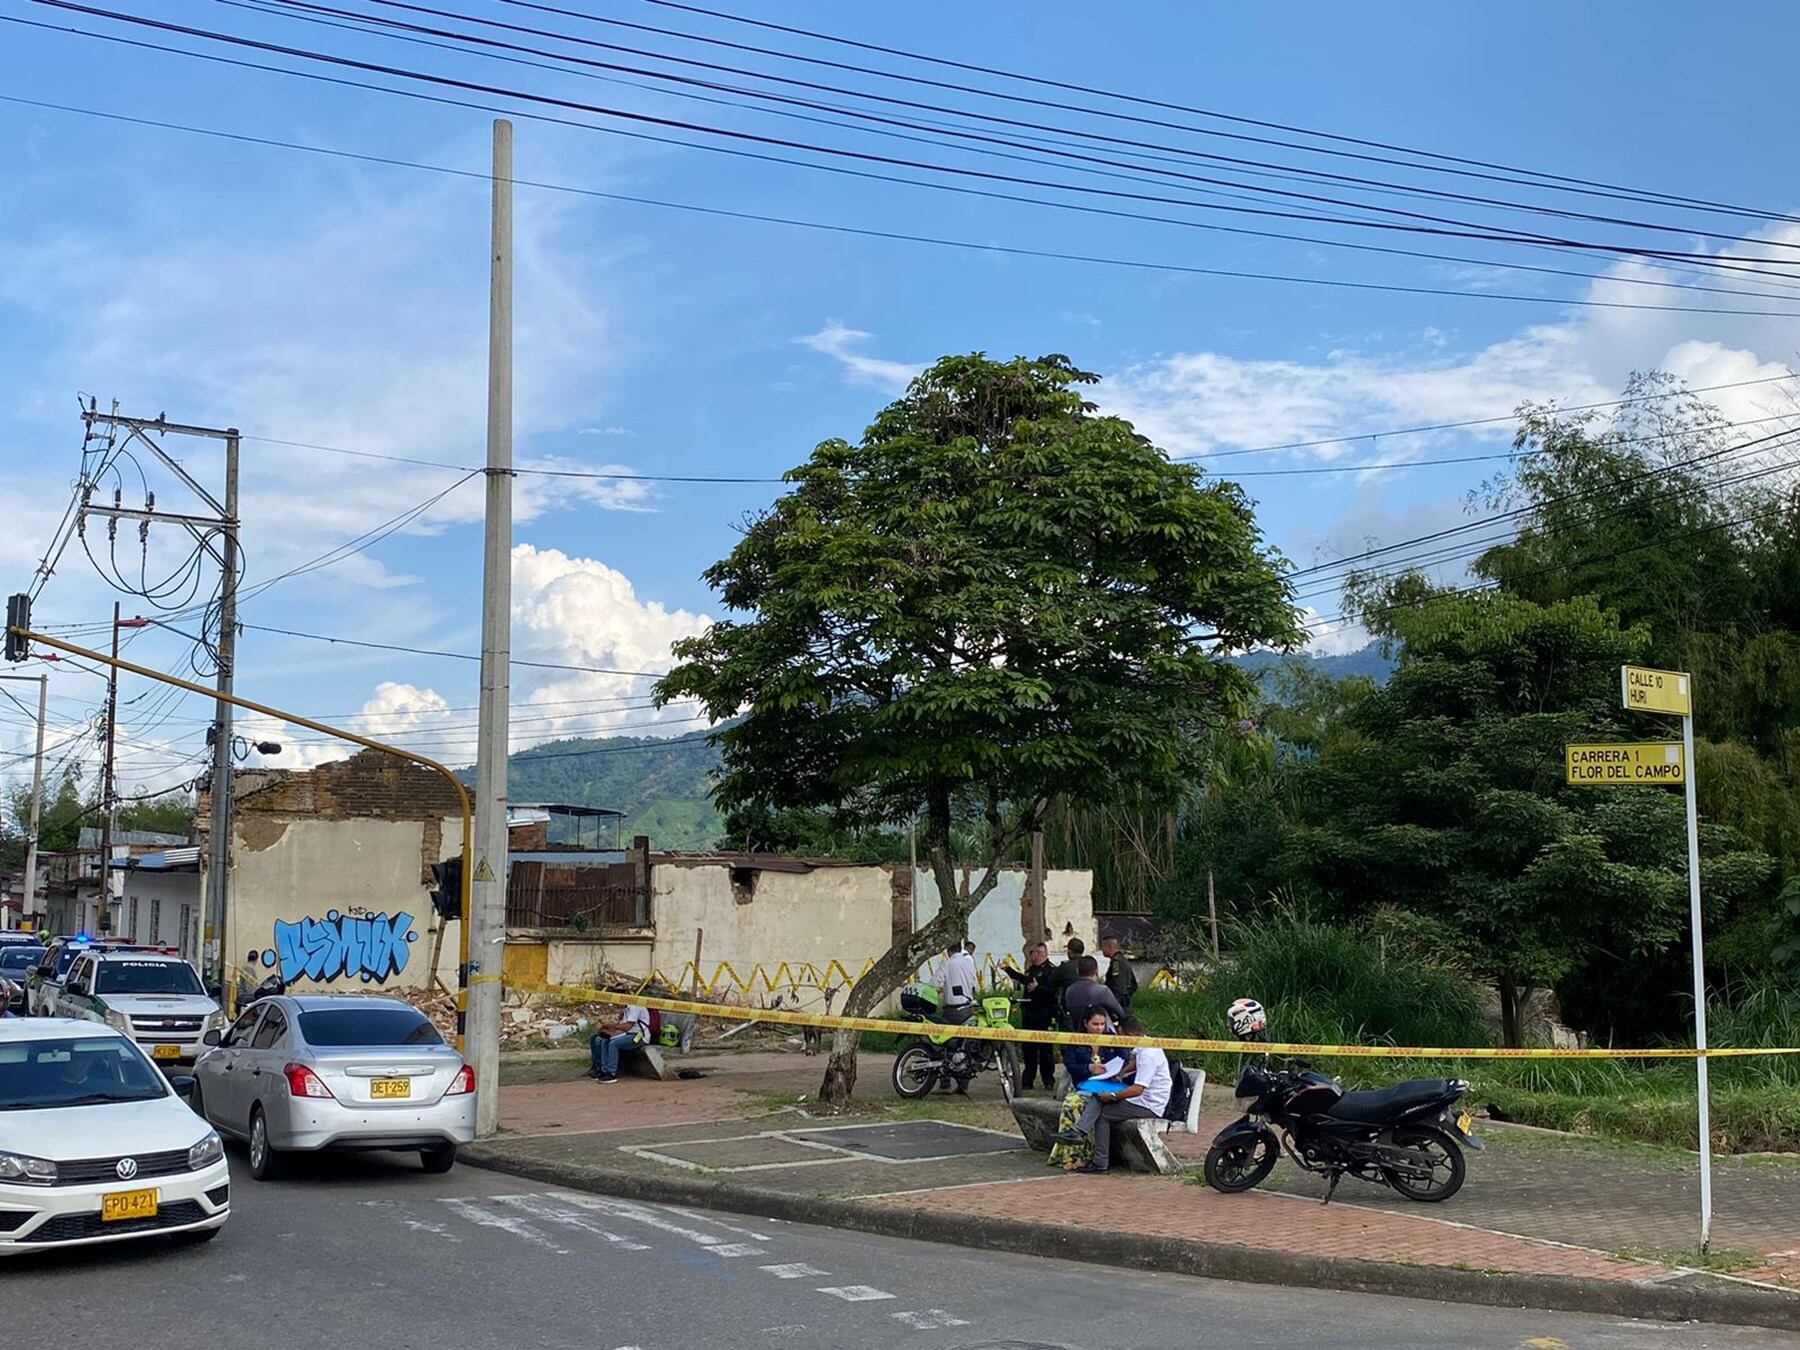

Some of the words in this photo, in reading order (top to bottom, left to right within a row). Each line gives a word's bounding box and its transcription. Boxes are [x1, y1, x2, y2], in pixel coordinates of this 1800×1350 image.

[1629, 672, 1654, 688] CALLE
[1655, 676, 1664, 689] 10
[1571, 750, 1631, 763] CARRERA
[1635, 750, 1640, 763] 1
[1571, 766, 1603, 779] FLOR
[1607, 765, 1631, 779] DEL
[1635, 765, 1681, 779] CAMPO
